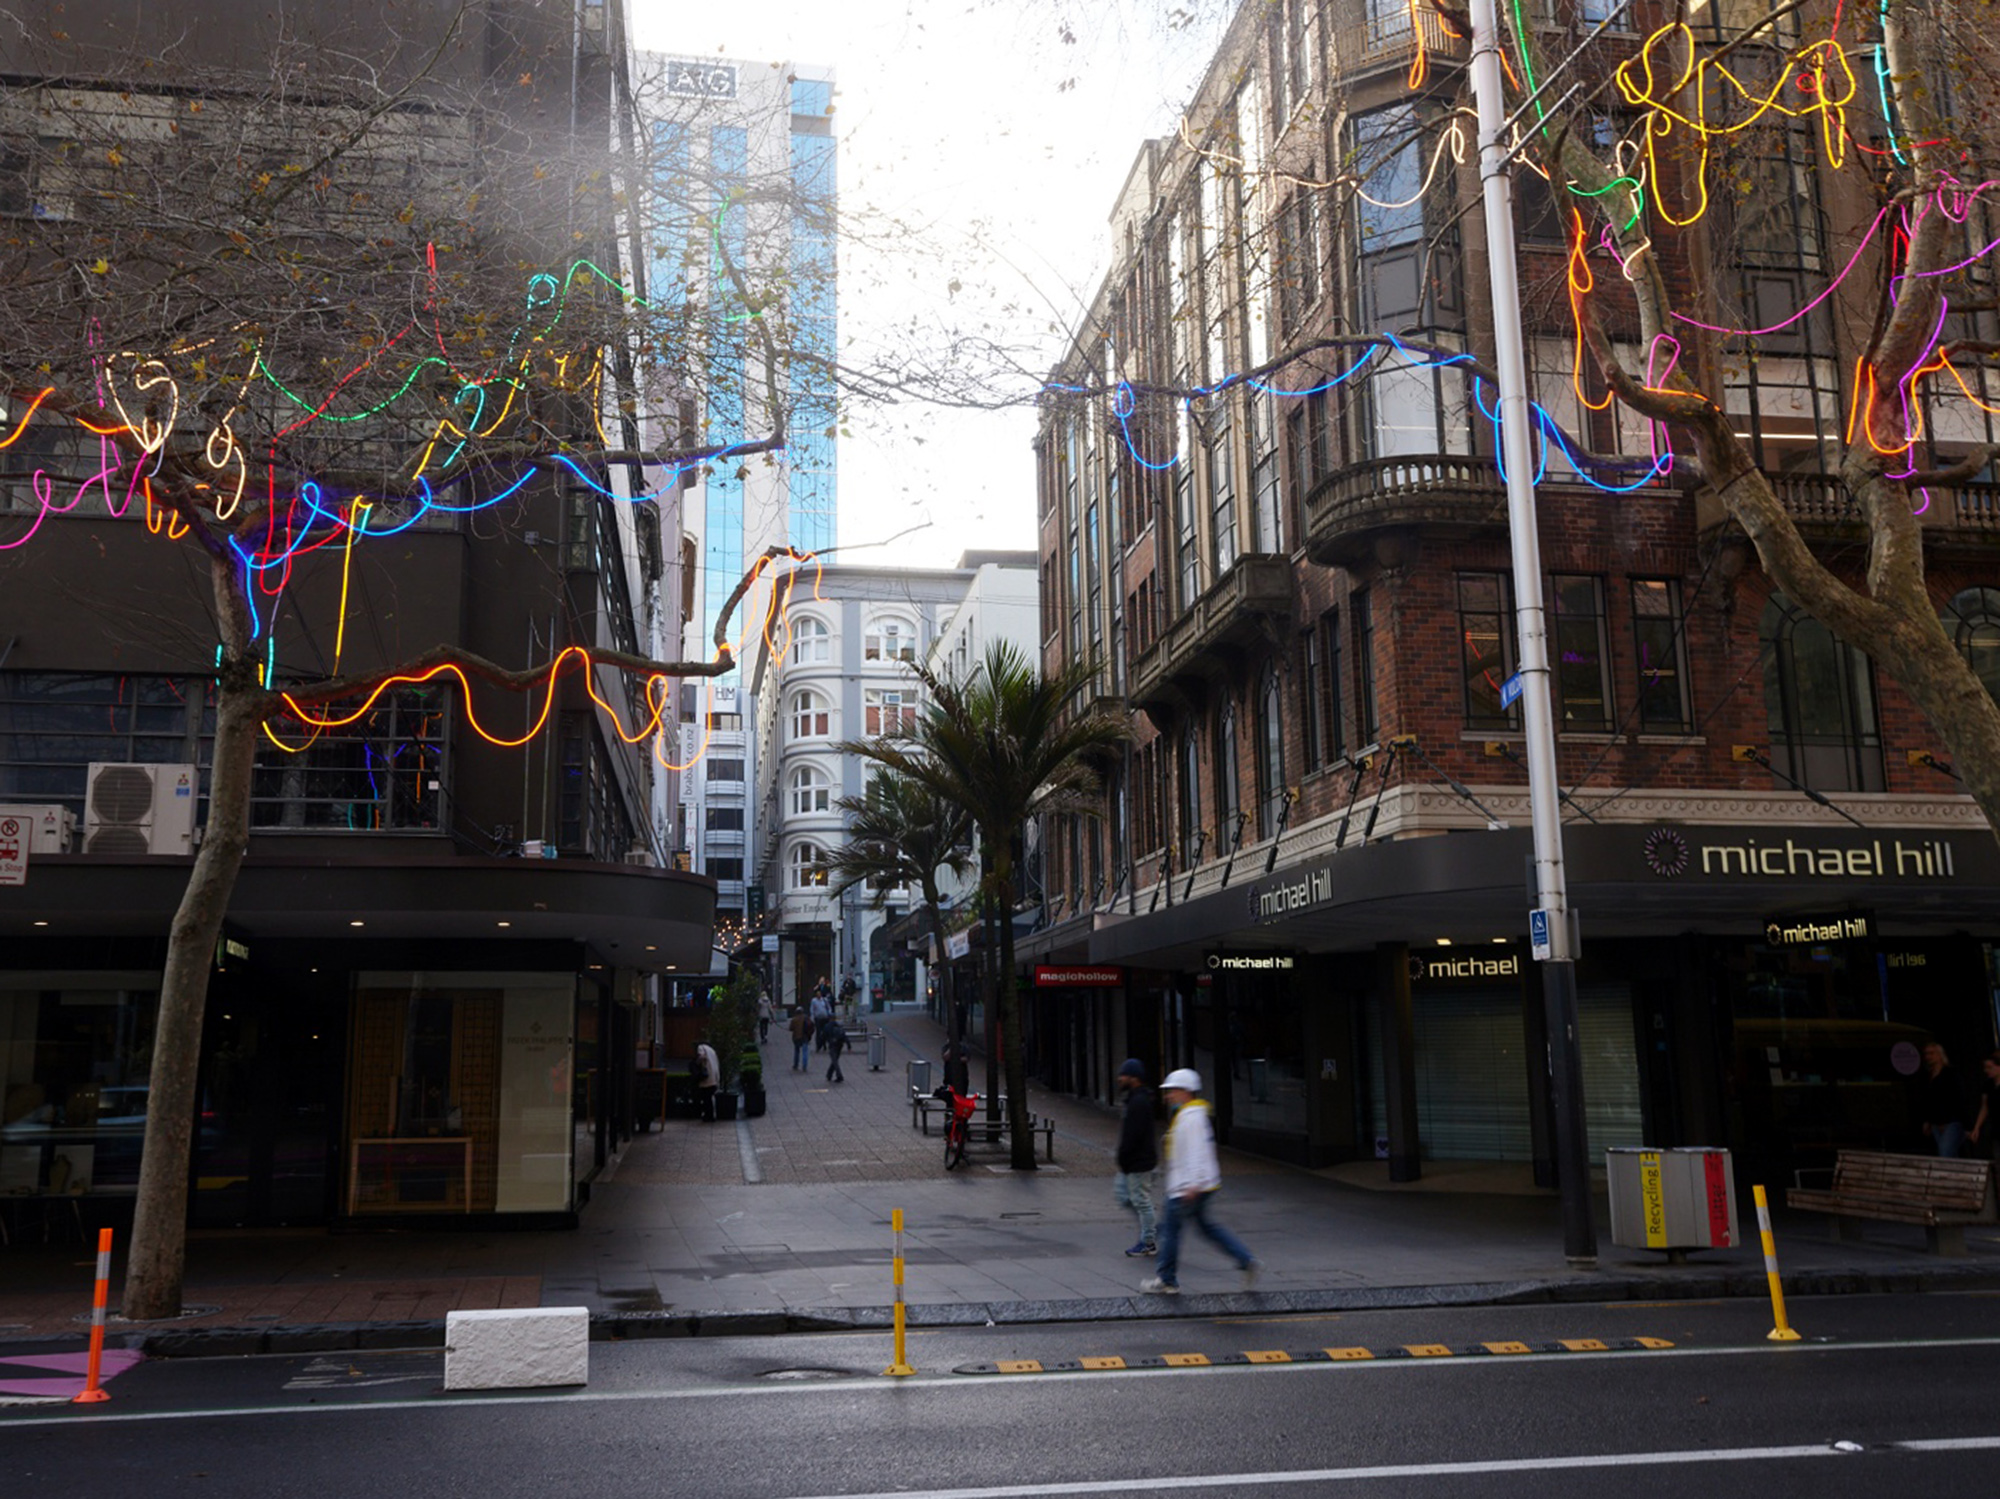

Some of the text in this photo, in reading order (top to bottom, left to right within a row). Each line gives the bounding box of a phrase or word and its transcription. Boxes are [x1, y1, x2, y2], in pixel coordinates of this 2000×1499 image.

[674, 67, 731, 93] AIG
[4, 862, 24, 873] Stop
[1702, 838, 1954, 877] michael hill
[1260, 867, 1334, 917] michael hill
[1783, 917, 1868, 943] michael hill
[1222, 955, 1294, 968] michael hill
[1429, 955, 1519, 978] michael
[1040, 972, 1118, 982] magichollow
[1647, 1169, 1661, 1234] Recycling
